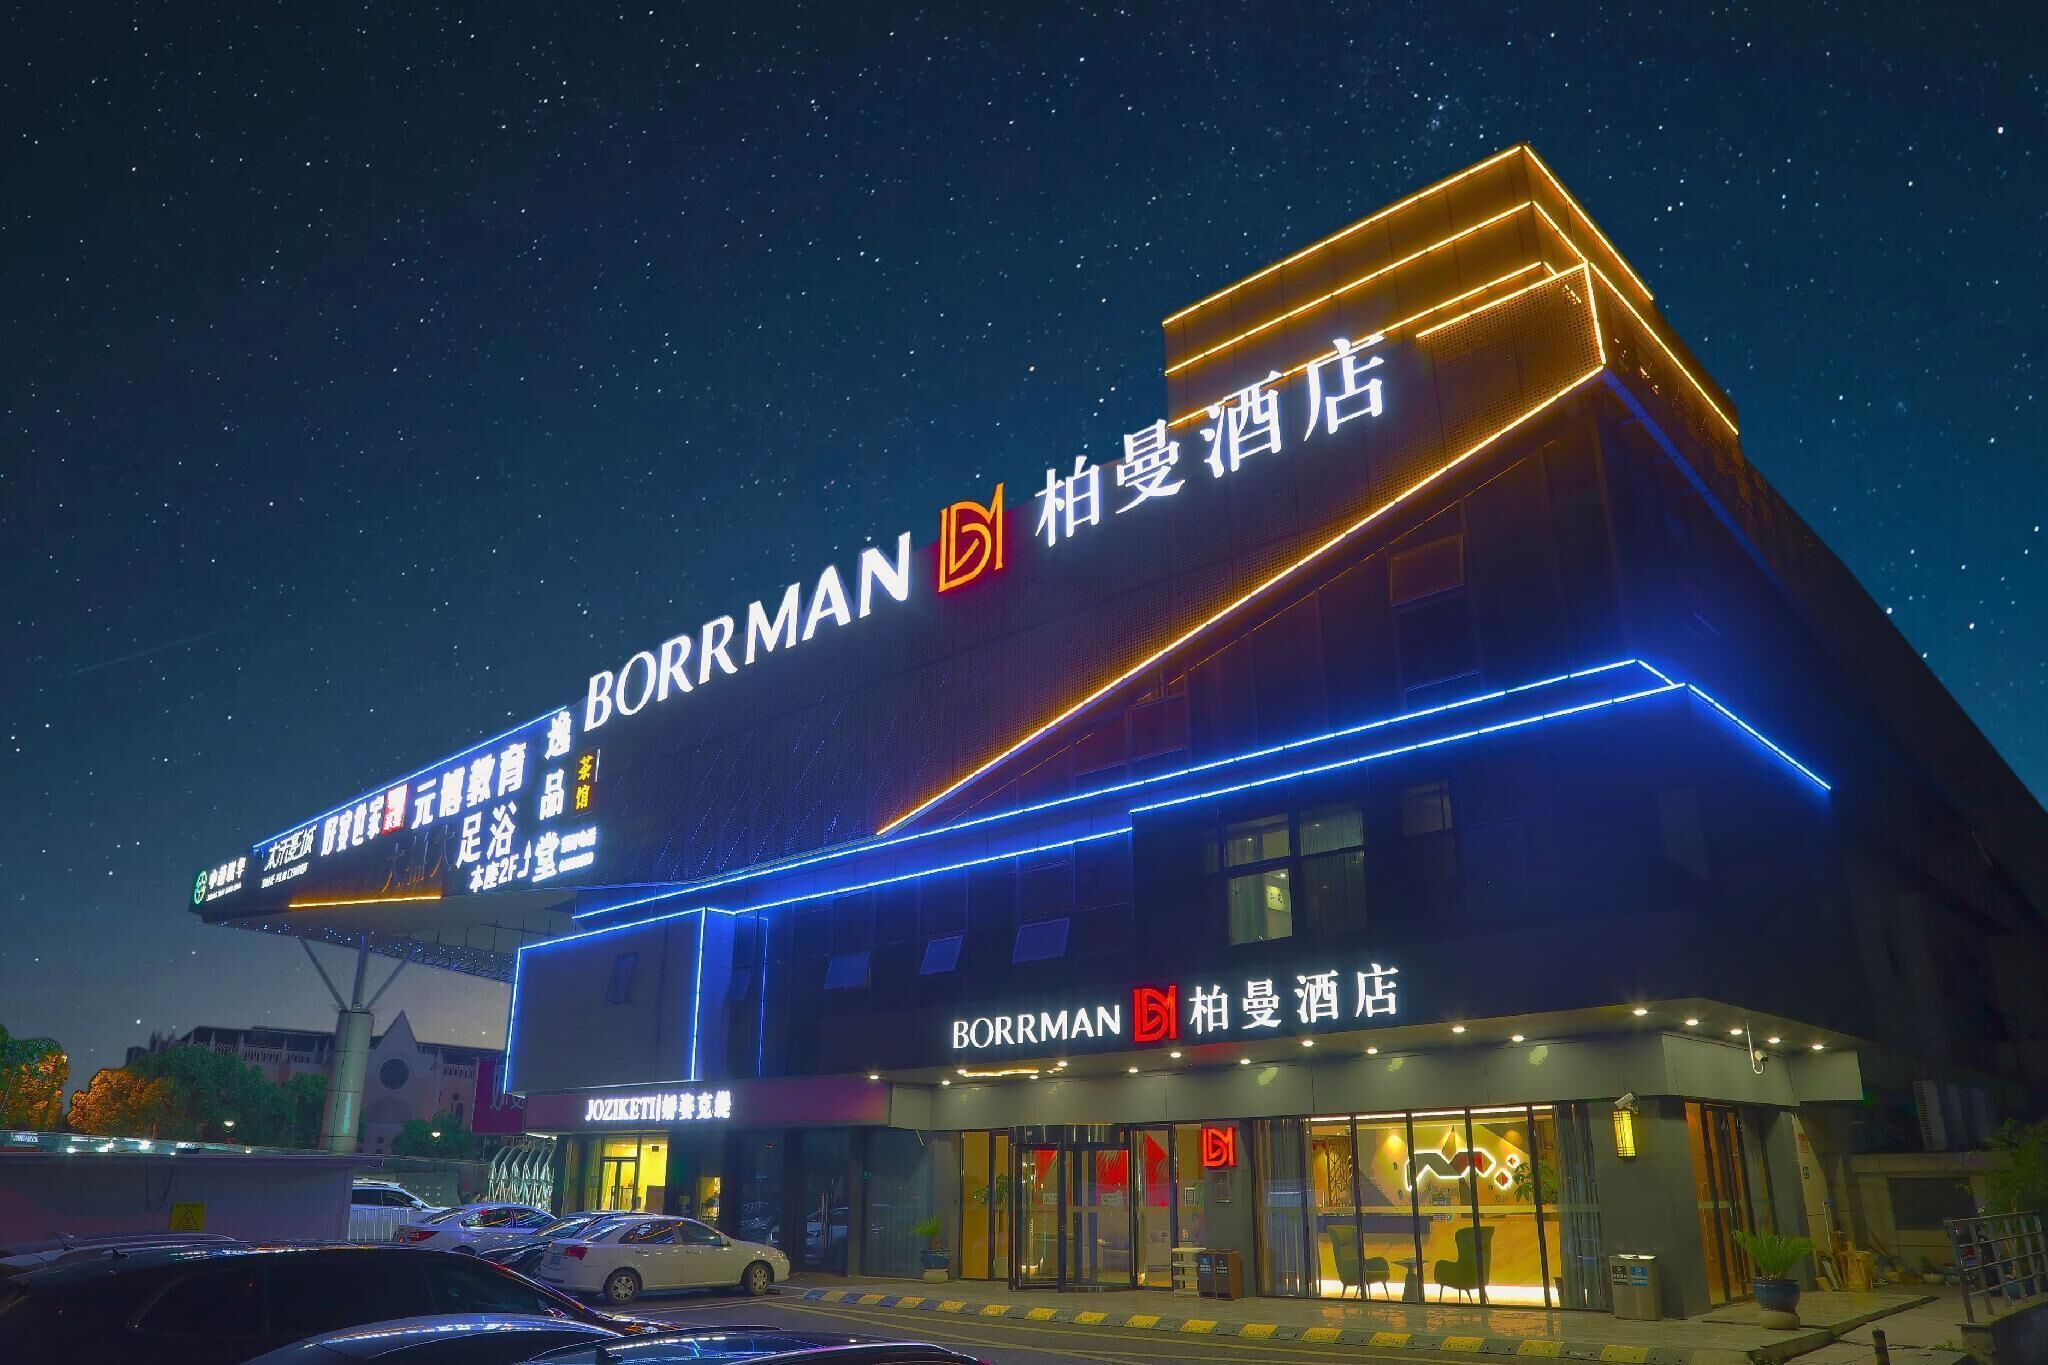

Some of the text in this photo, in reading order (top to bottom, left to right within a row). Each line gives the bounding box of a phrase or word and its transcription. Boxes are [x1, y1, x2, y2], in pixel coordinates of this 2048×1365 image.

[1034, 335, 1386, 547] 柏曼酒店
[584, 532, 911, 731] BORRMAN
[575, 754, 593, 810] 茶馆
[456, 800, 517, 868] 足浴
[953, 1004, 1121, 1049] BORRMAN
[1188, 963, 1399, 1035] 柏曼酒店
